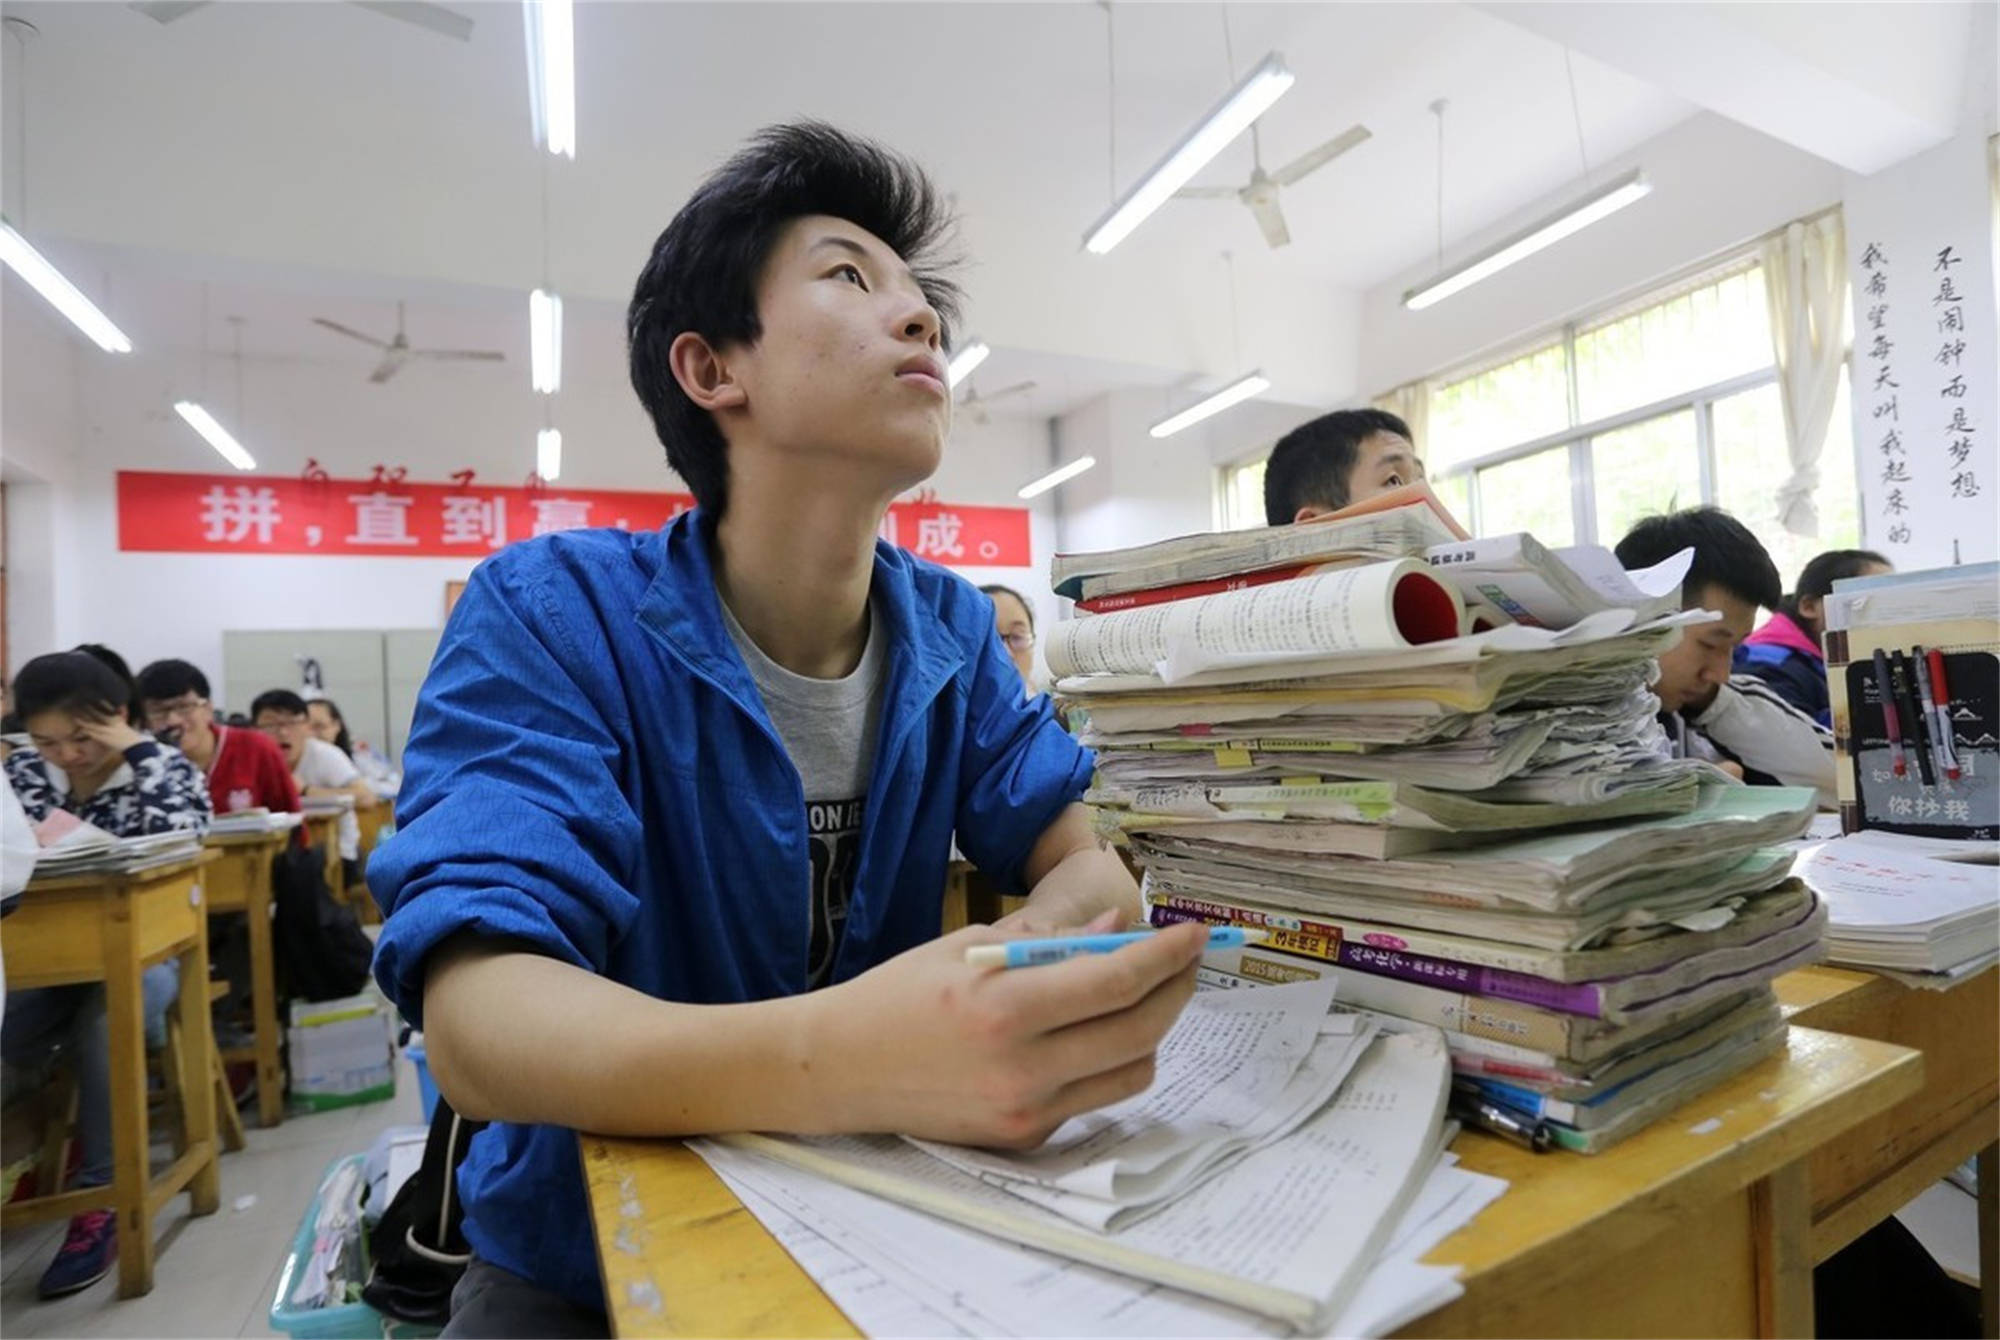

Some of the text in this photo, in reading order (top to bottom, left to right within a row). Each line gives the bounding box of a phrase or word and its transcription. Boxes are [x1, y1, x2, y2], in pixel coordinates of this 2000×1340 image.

[1934, 246, 1981, 498] 不是闹钟而是梦想
